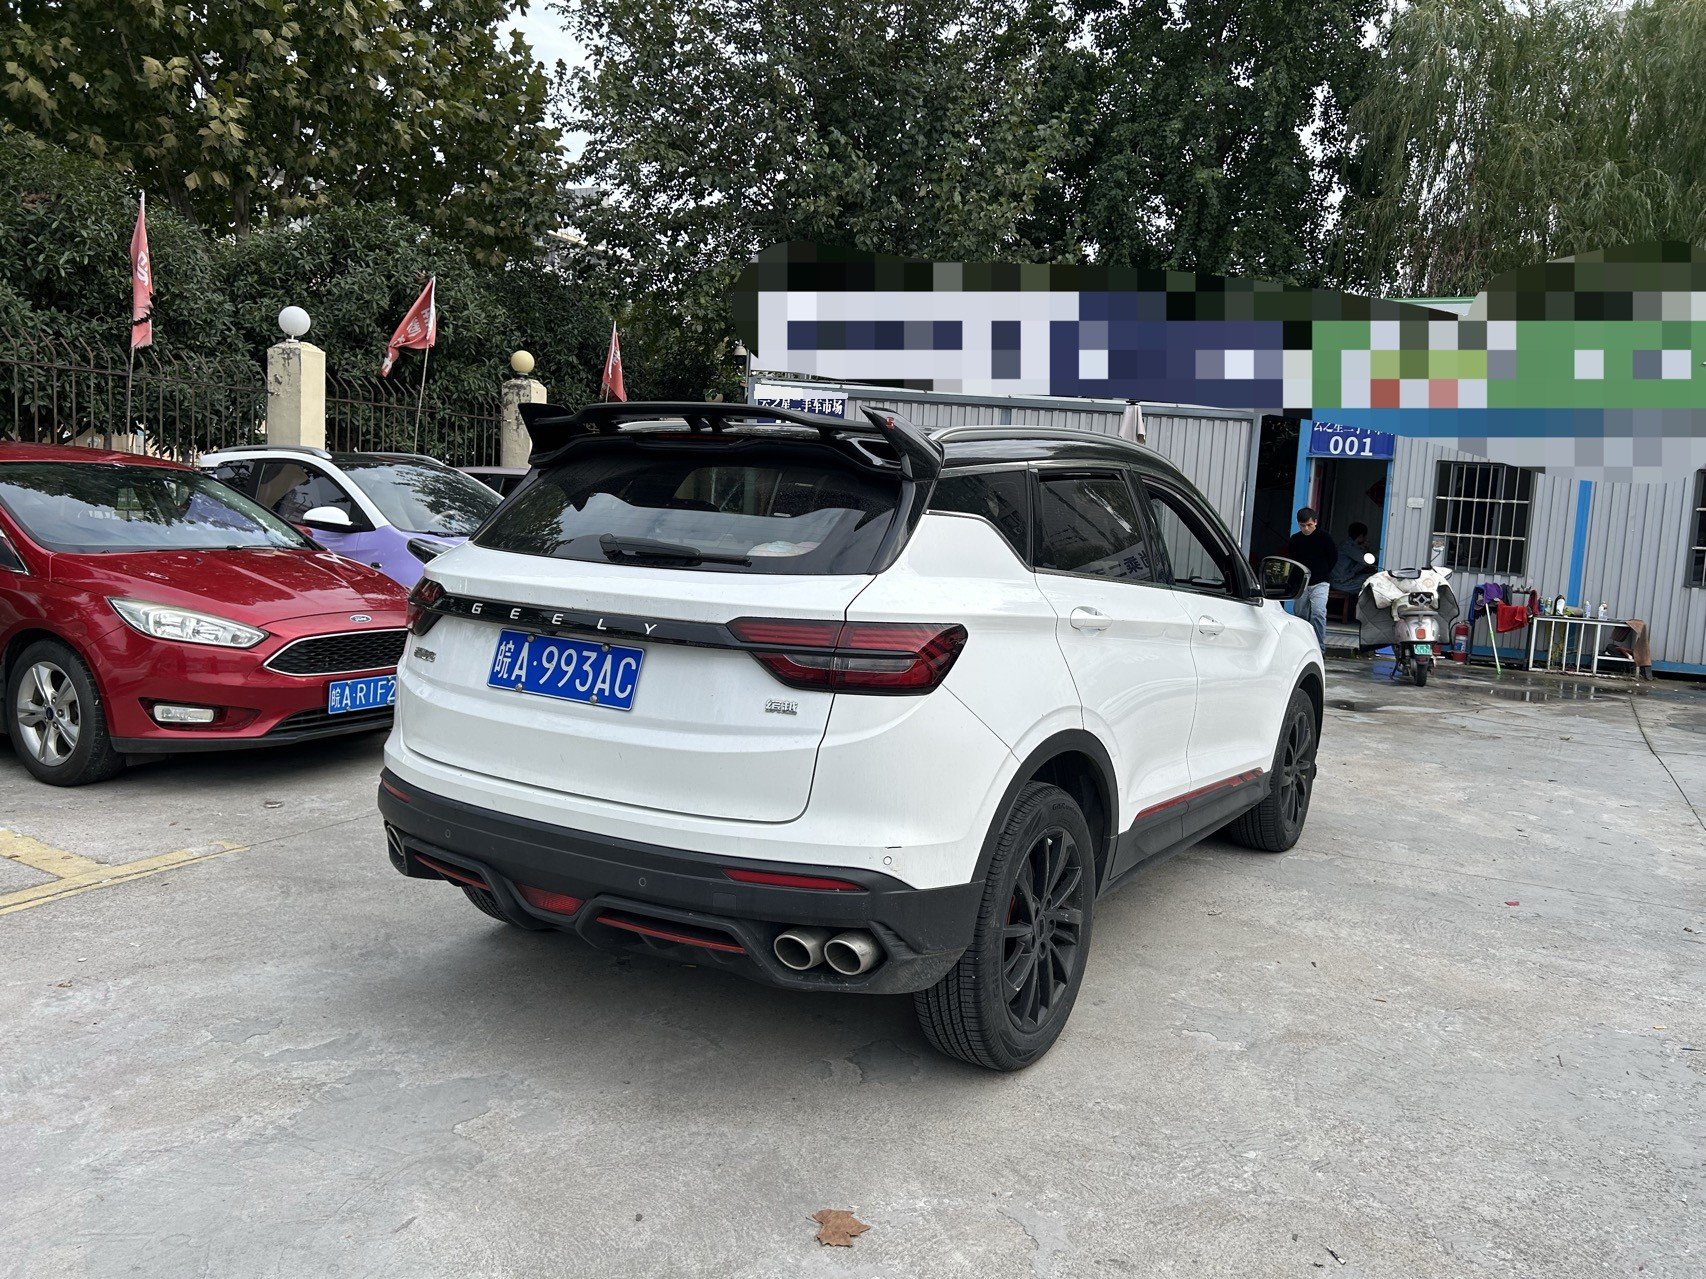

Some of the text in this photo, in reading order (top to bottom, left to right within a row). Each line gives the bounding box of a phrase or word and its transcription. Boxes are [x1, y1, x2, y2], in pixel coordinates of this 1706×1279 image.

[1329, 435, 1373, 456] 001
[471, 602, 659, 635] GEELY
[493, 639, 637, 699] 皖A·993AC
